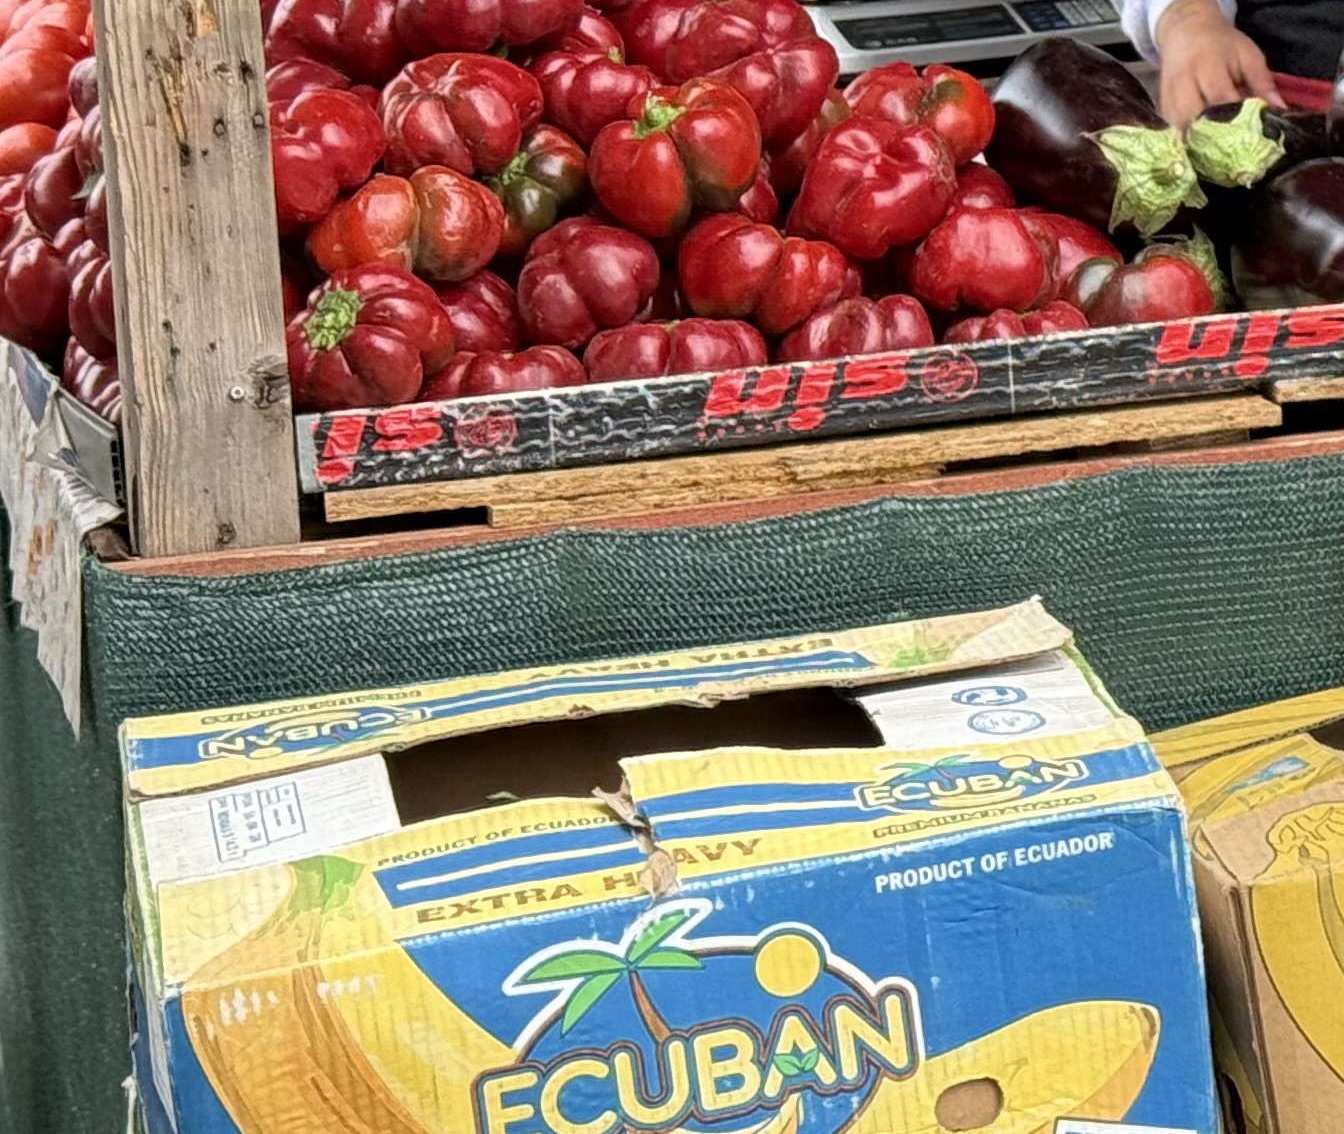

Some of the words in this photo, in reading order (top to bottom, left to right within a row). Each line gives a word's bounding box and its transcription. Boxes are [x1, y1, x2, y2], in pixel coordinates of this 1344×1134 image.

[310, 404, 443, 484] si
[858, 759, 1086, 807] ECUBAN
[377, 836, 485, 867] PRODUCT
[487, 827, 514, 845] OF
[875, 856, 976, 894] PRODUCT
[980, 850, 1008, 874] OF
[1014, 831, 1115, 866] ECUADOR
[416, 882, 584, 925] EXTRA
[603, 837, 763, 893] HAVY
